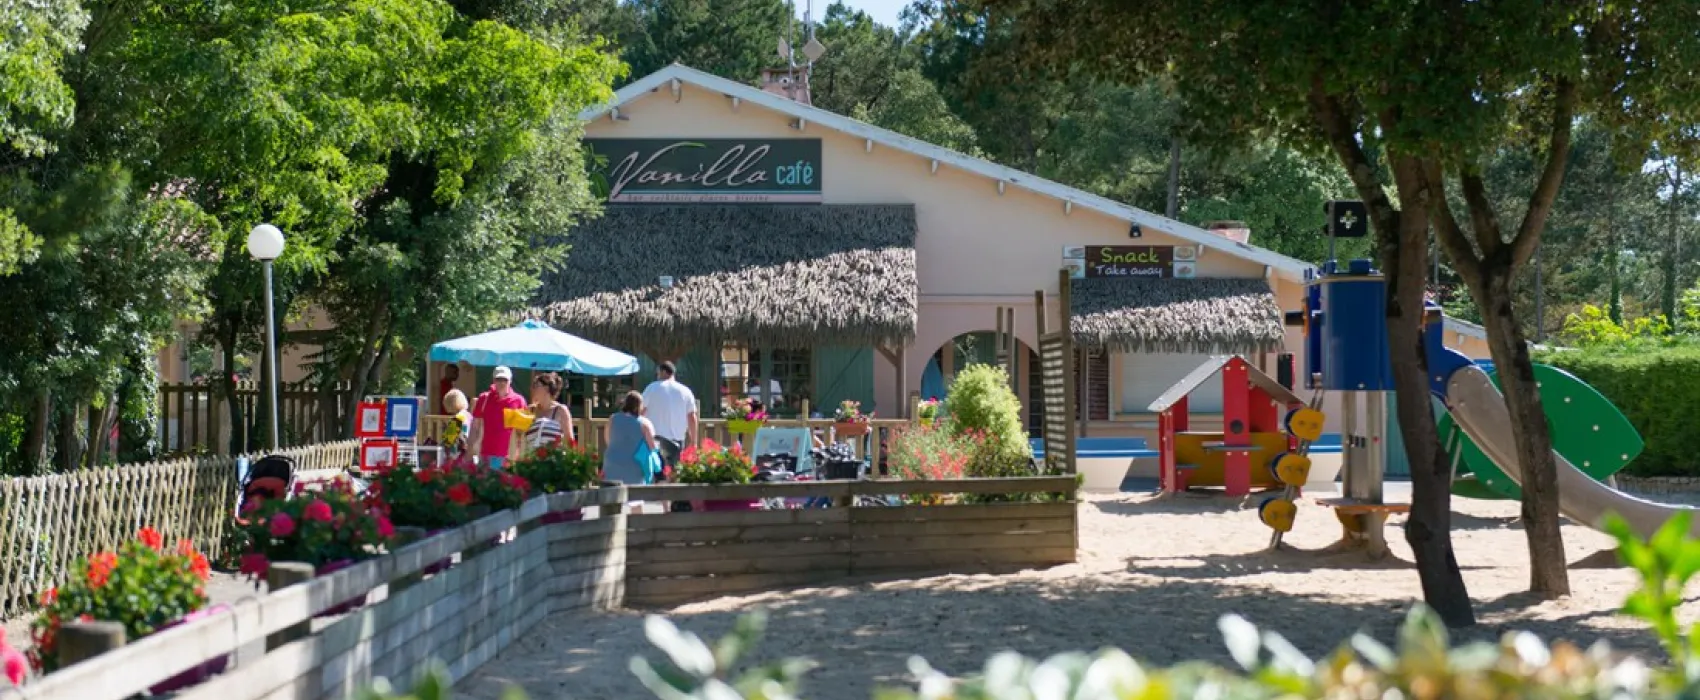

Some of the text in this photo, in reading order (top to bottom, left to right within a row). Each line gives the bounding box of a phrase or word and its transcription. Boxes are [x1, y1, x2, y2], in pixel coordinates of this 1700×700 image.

[611, 141, 814, 199] Vanilla café
[1101, 247, 1160, 262] Snack
[1095, 264, 1163, 278] Take away
